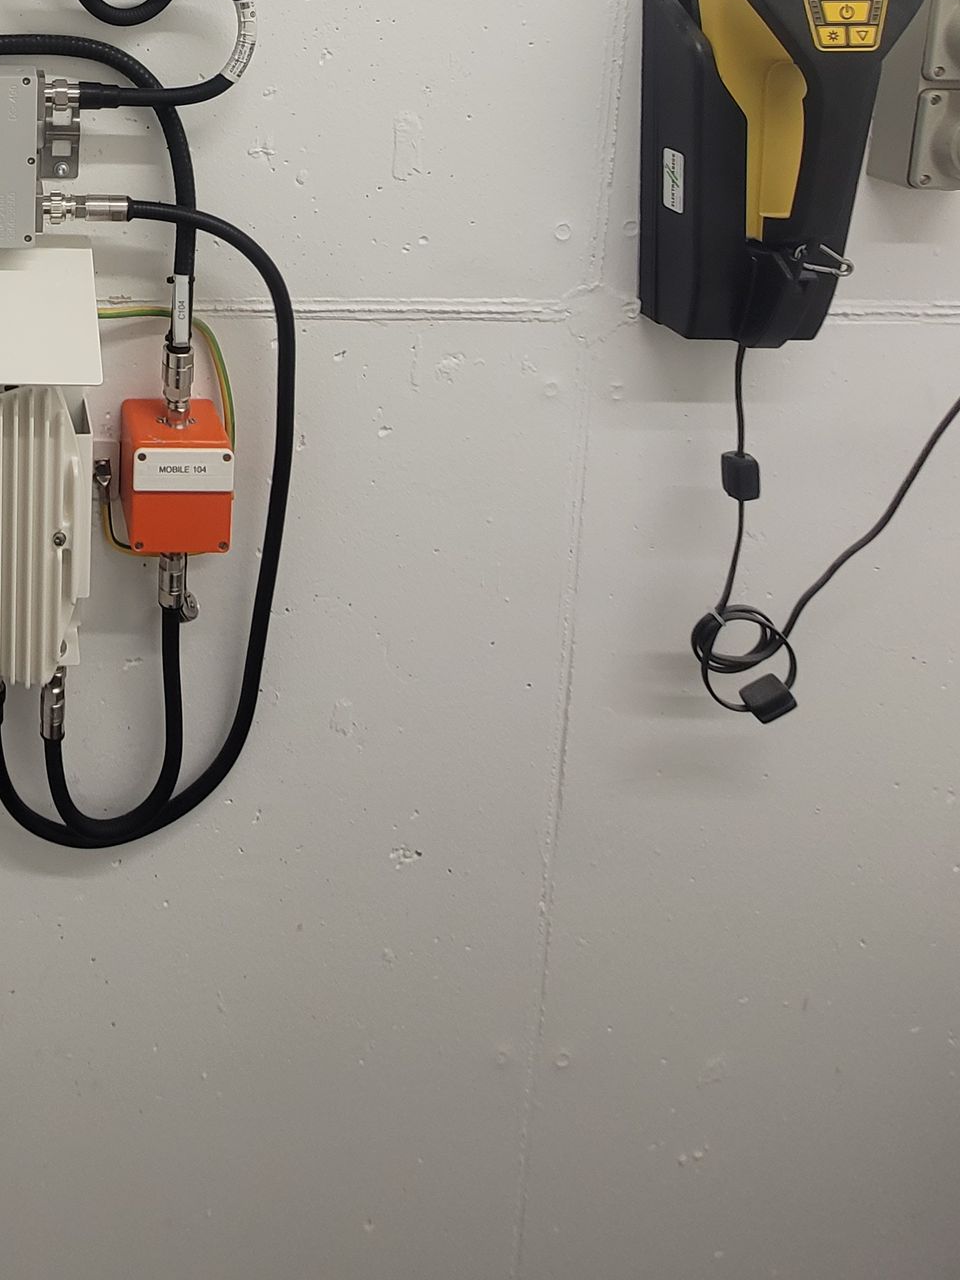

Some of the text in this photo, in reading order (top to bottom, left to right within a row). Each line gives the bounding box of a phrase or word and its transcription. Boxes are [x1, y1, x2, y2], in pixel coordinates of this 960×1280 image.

[178, 300, 186, 320] C104
[158, 465, 207, 474] MOBILE 104
